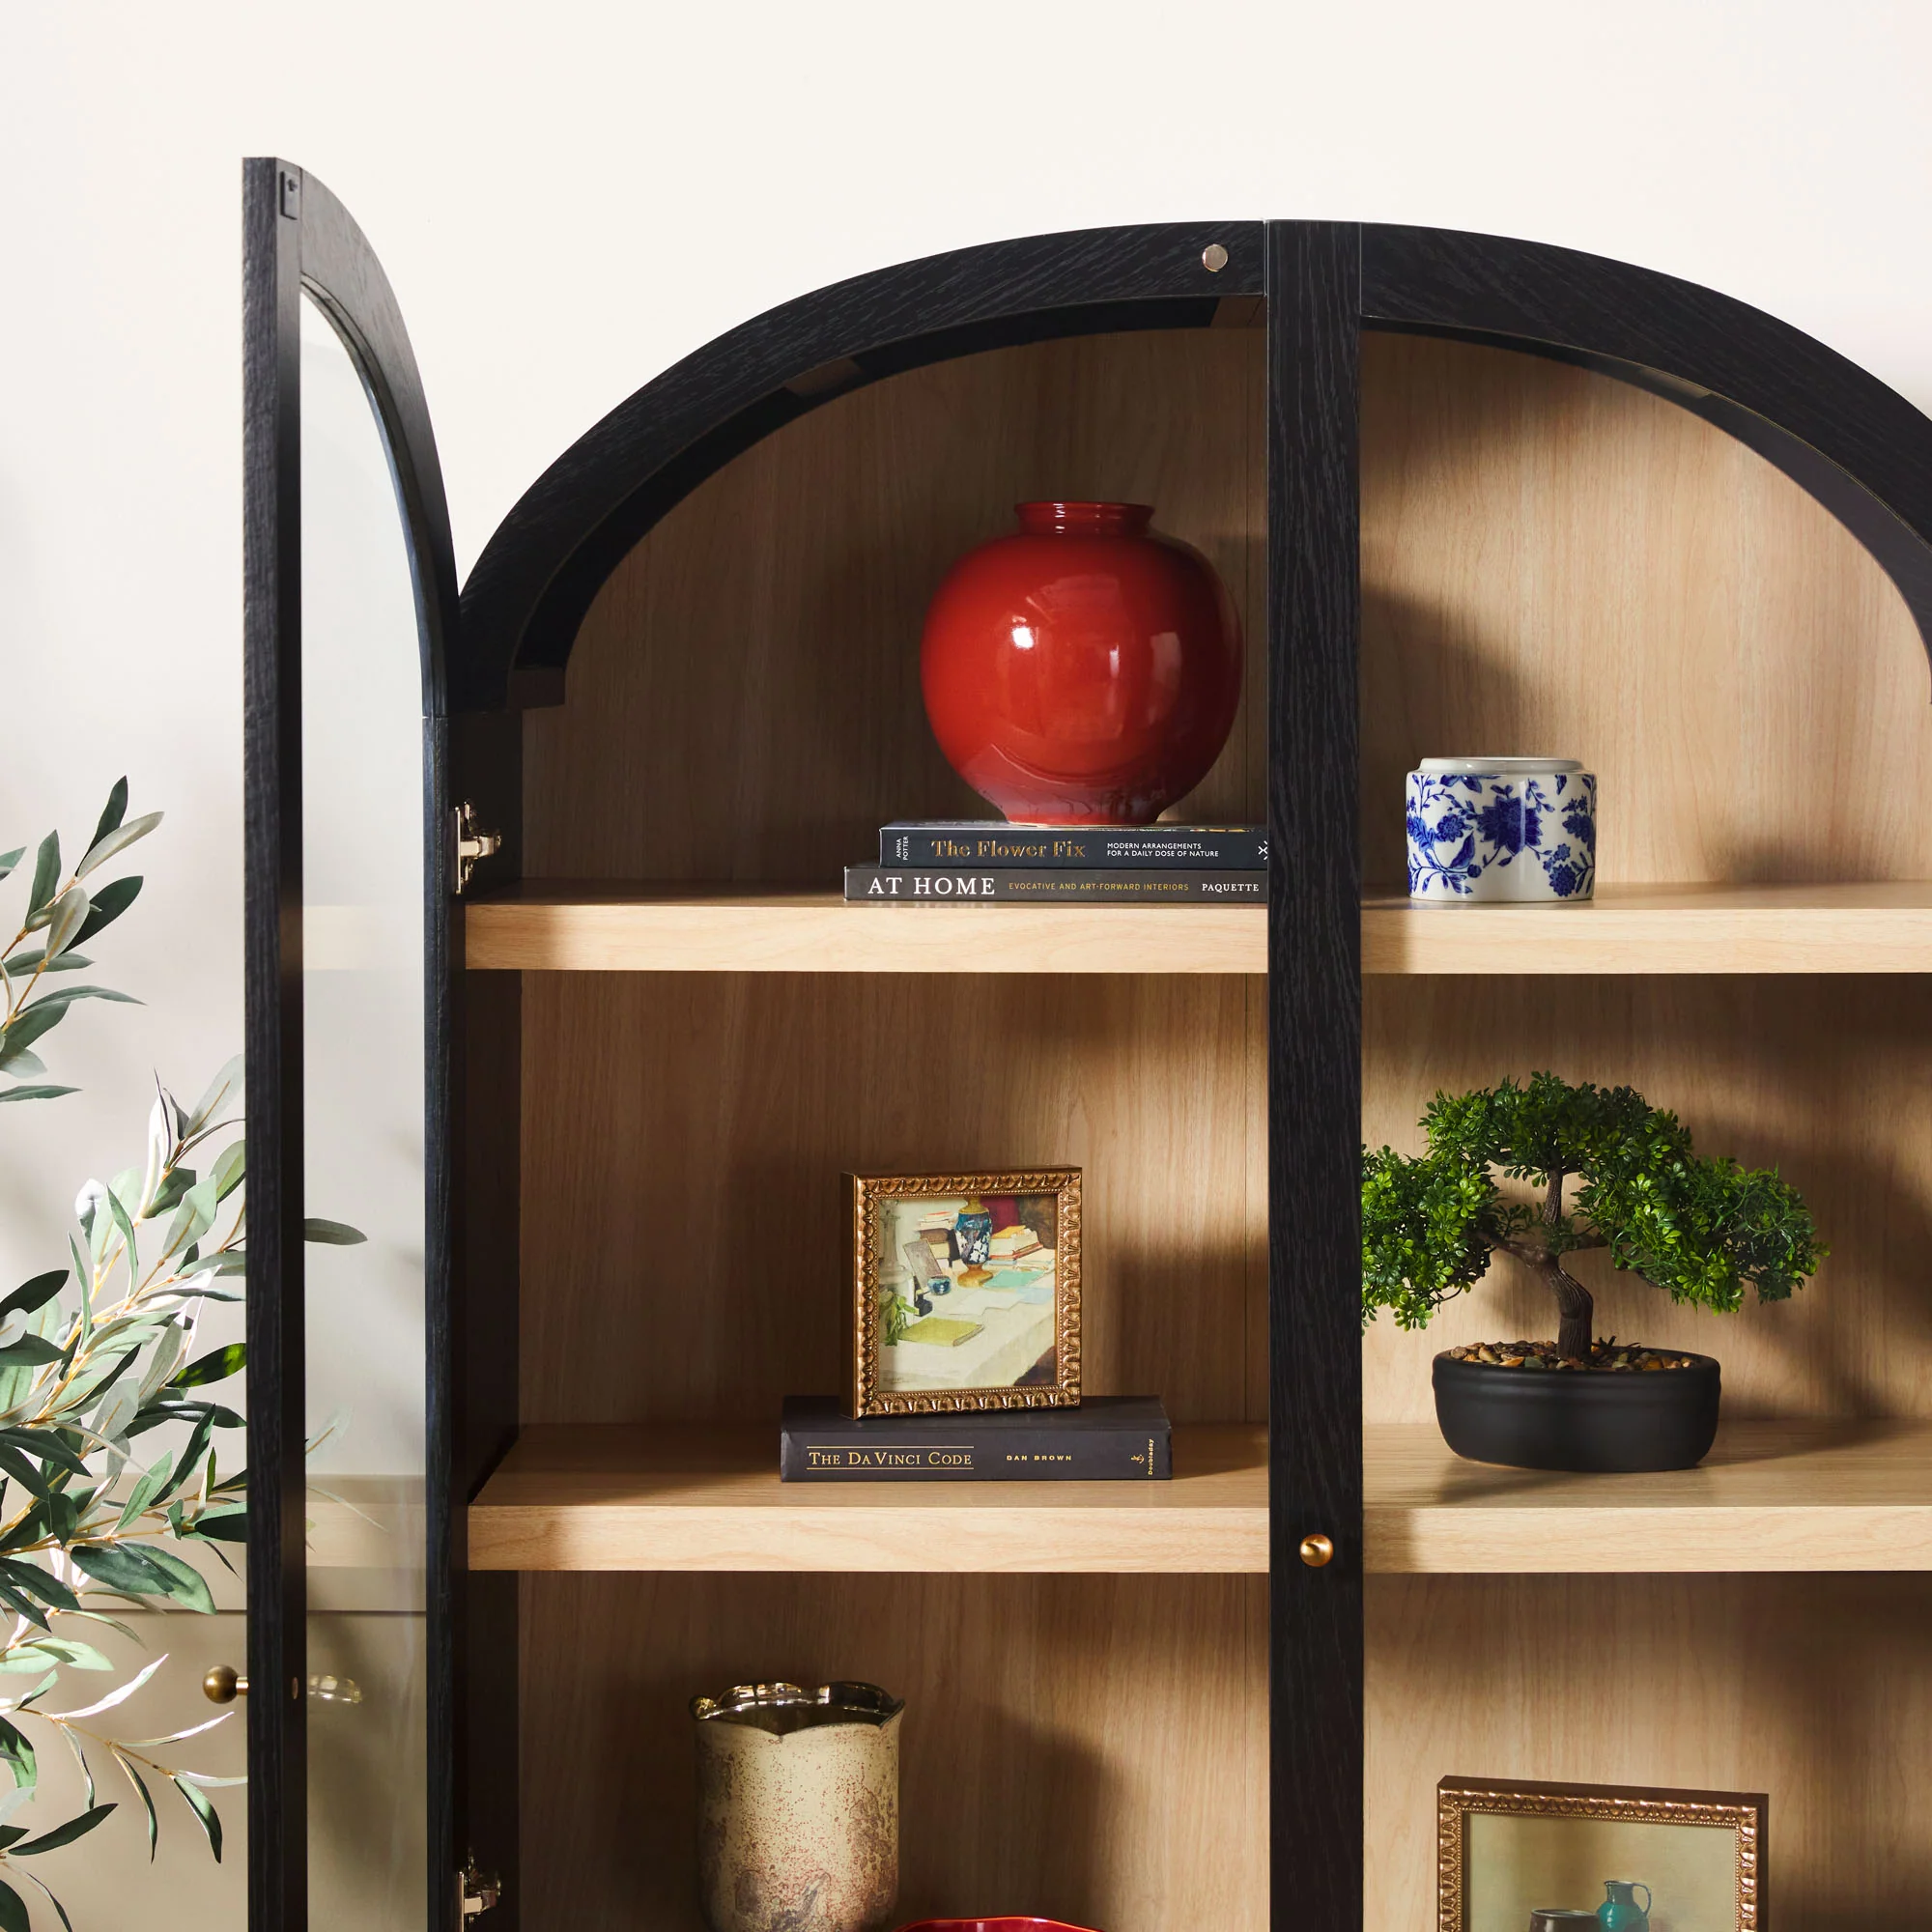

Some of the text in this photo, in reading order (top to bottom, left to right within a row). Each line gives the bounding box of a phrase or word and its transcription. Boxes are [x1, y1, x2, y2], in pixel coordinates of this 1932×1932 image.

[930, 839, 1087, 858] The Flower Fix
[867, 876, 995, 895] AT HOME
[1009, 882, 1189, 892] EVOCATIVE AND ART-FORWARD INTERIORS
[1202, 883, 1260, 894] PAQUETTE
